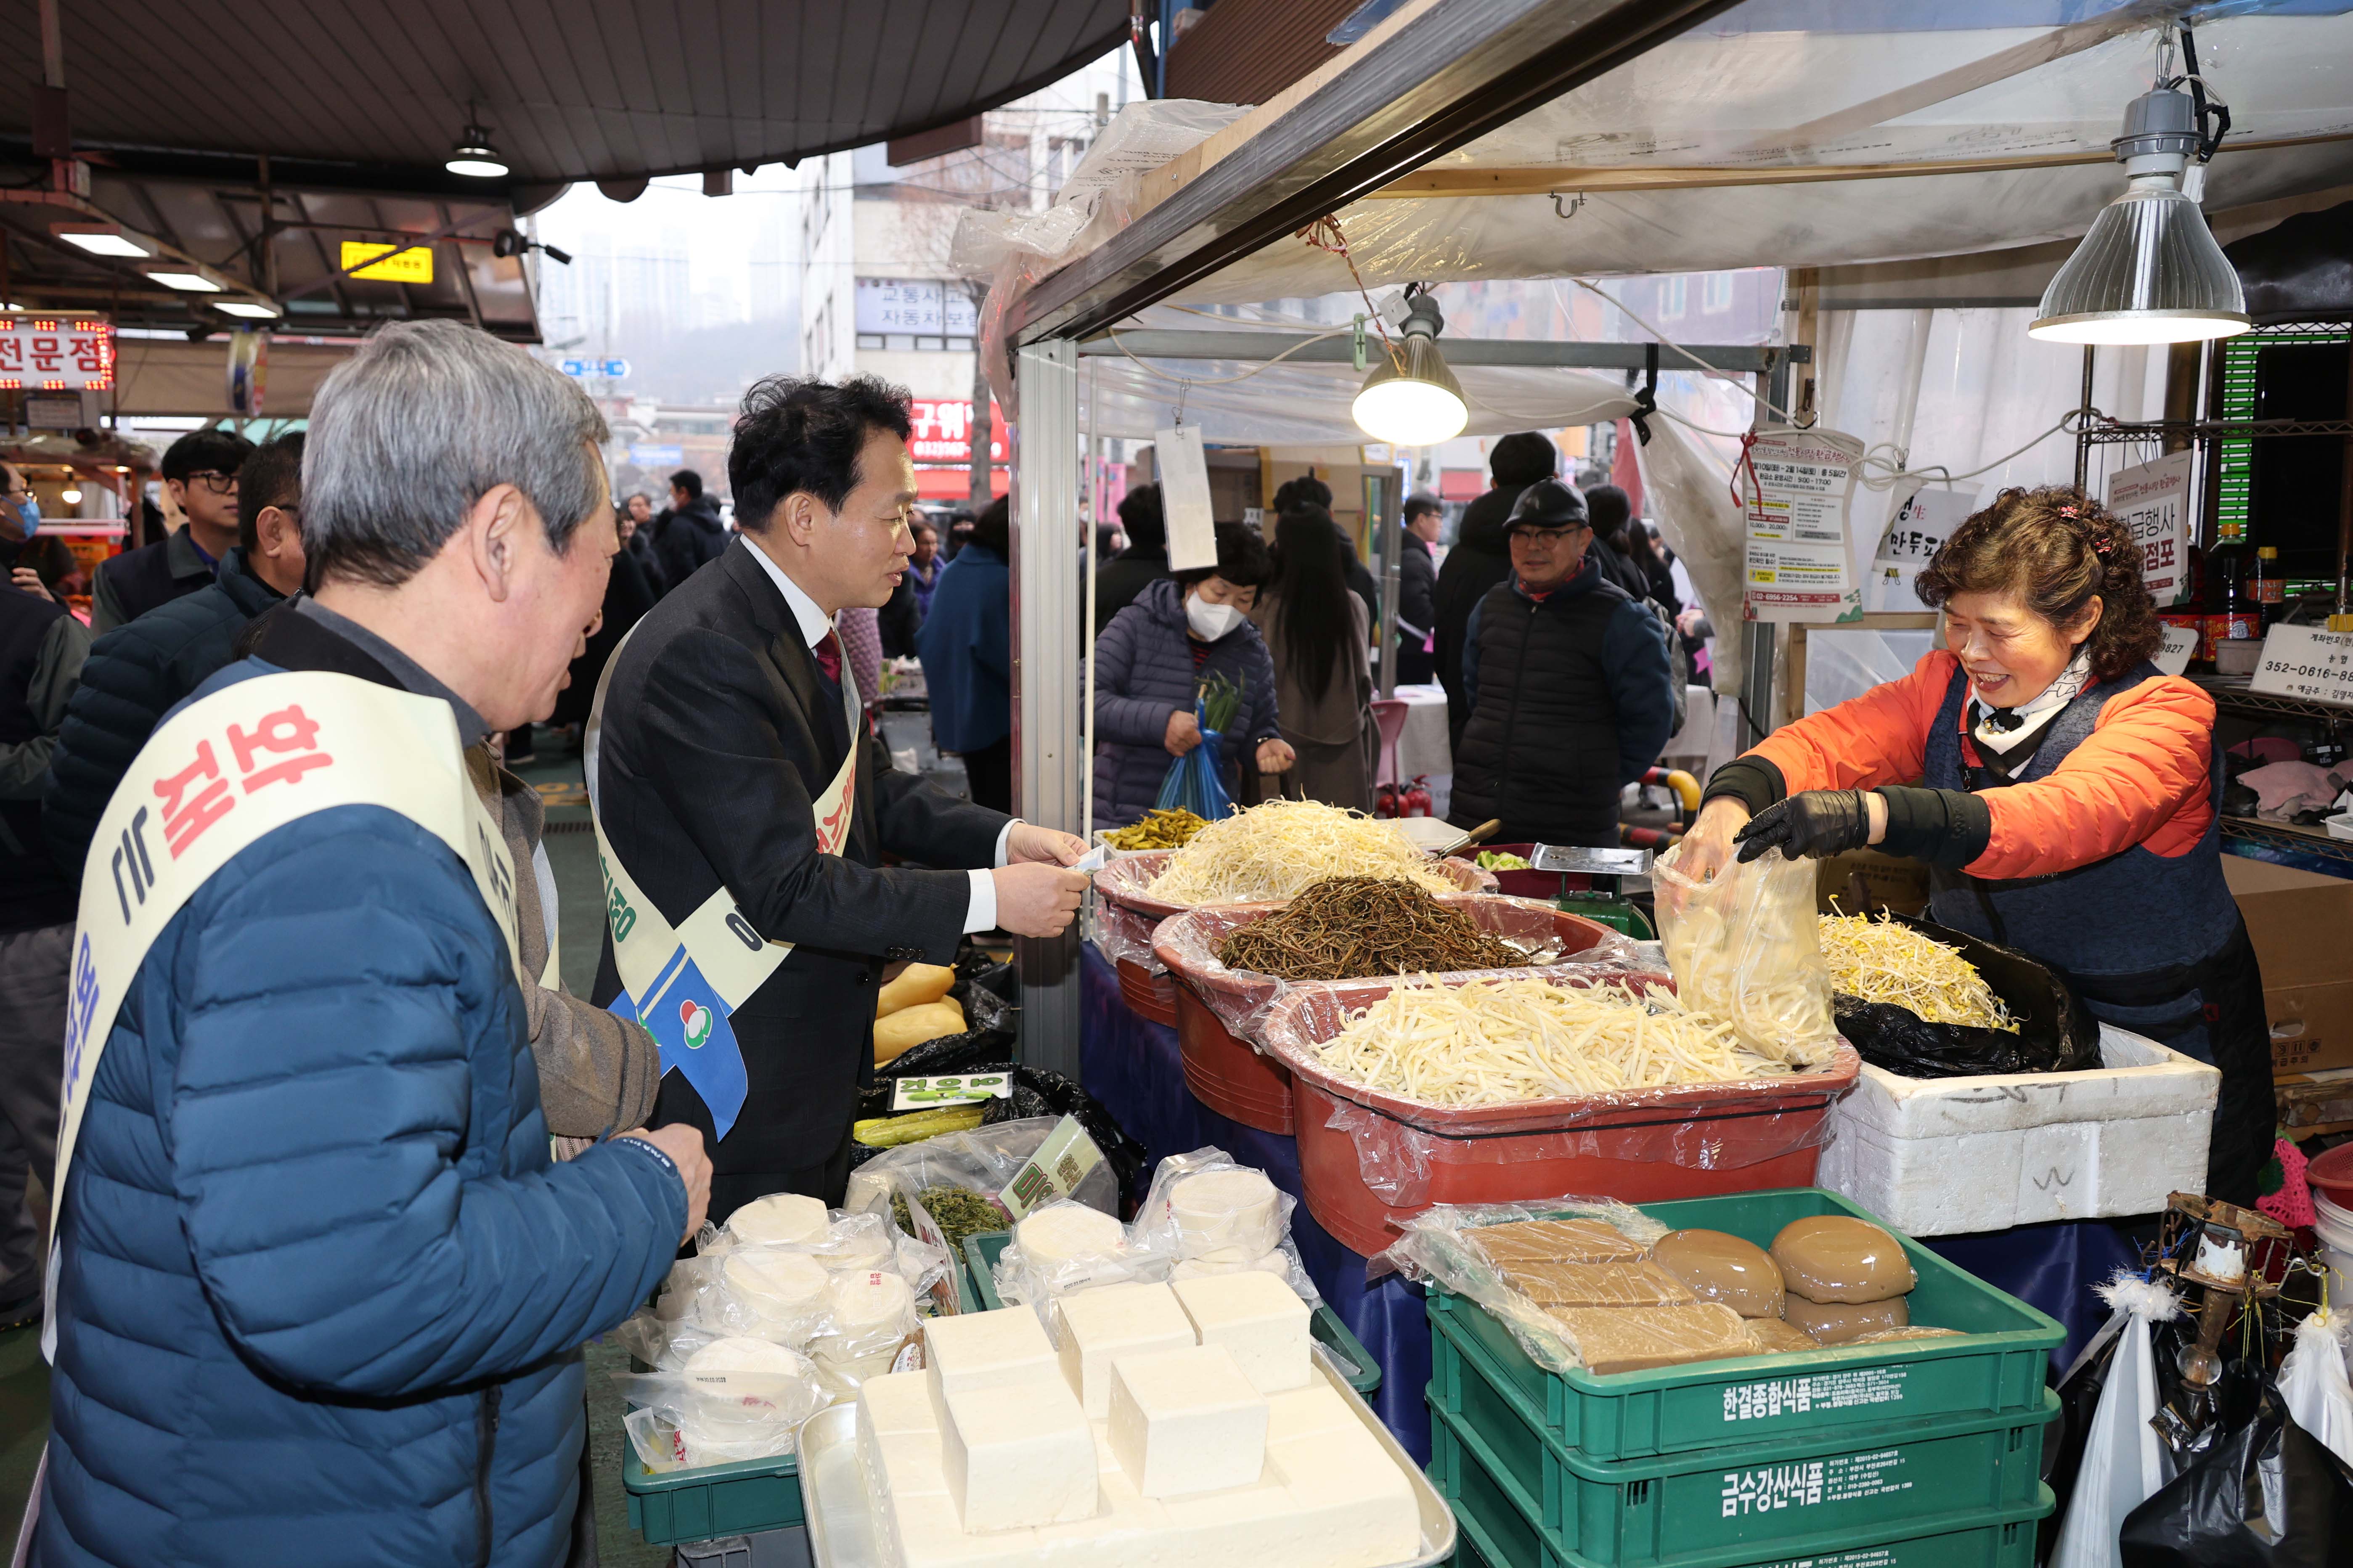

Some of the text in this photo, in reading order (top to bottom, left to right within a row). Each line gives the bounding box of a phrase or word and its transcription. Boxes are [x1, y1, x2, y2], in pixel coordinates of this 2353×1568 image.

[2142, 538, 2175, 571] 점포
[2298, 685, 2320, 695] 예금주
[1723, 1378, 1812, 1421] 한결종합식품
[1722, 1462, 1824, 1518] 금수강산식품
